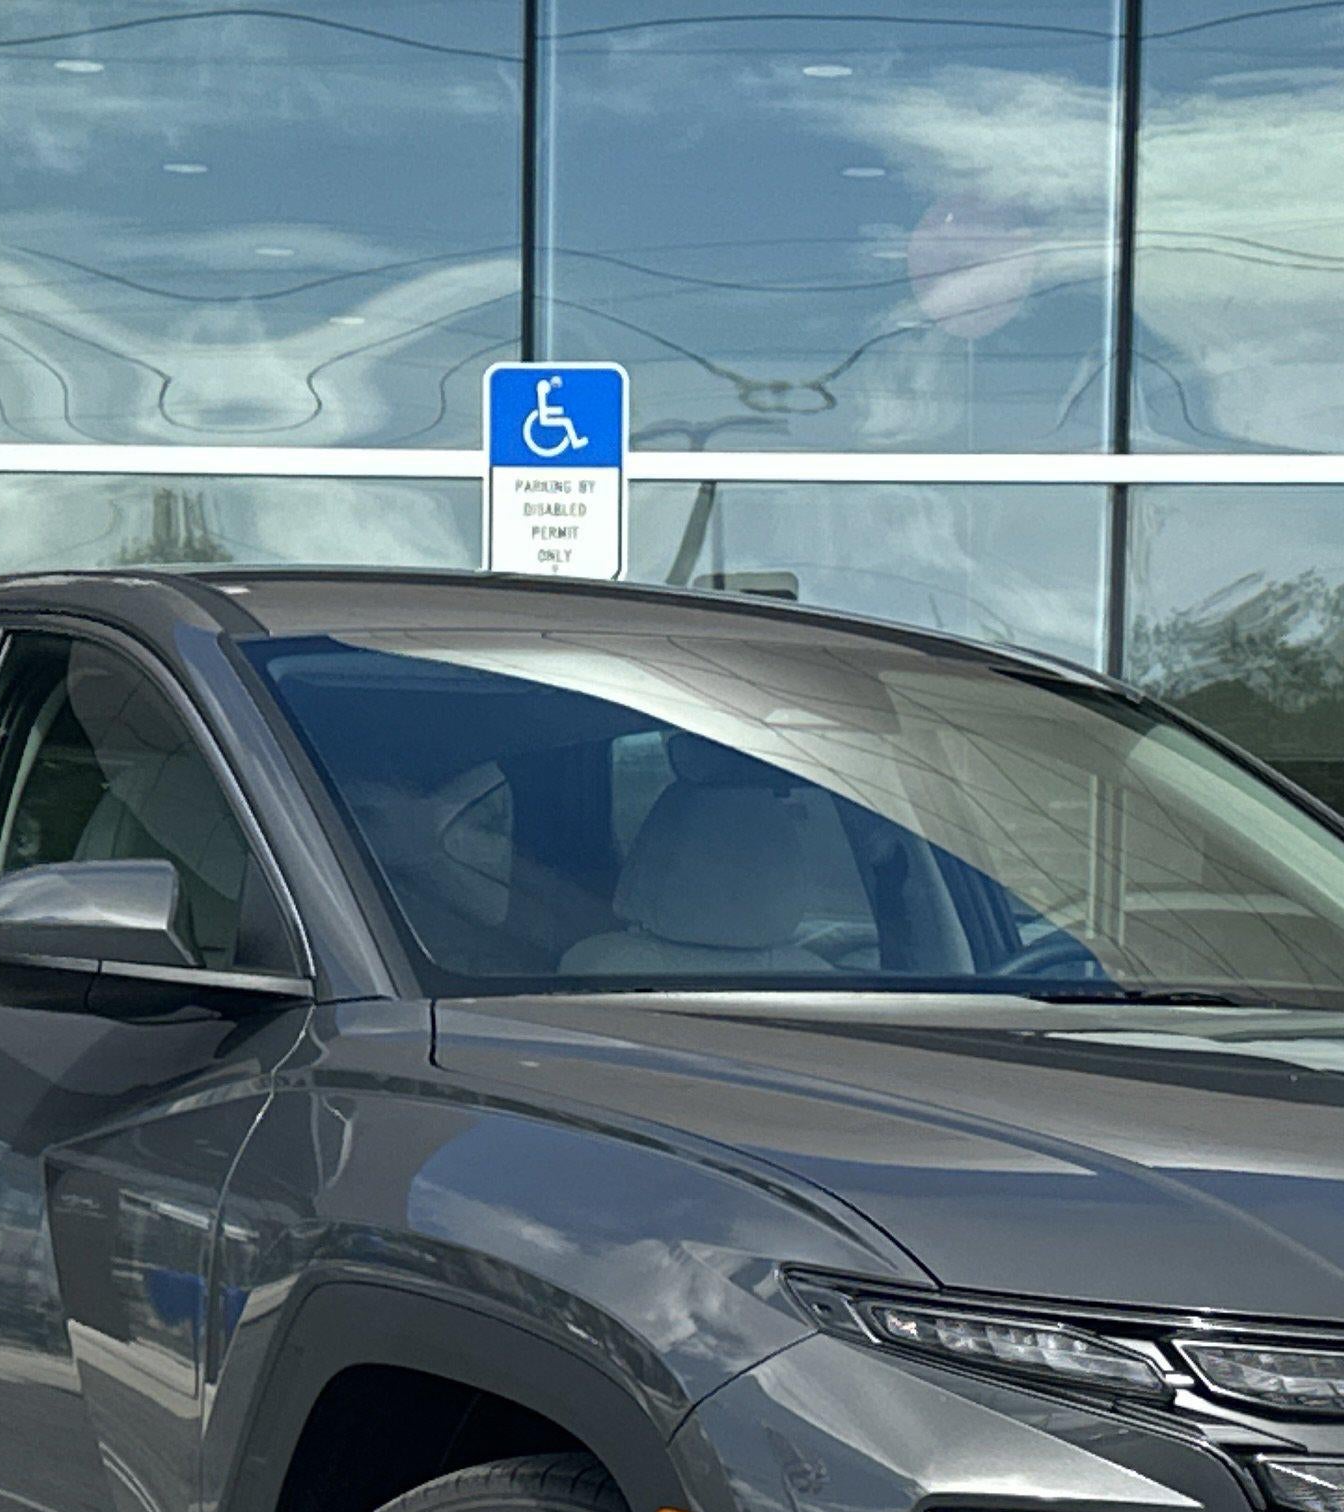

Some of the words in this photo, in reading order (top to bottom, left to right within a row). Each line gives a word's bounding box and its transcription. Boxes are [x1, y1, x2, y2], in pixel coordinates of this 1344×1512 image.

[514, 479, 572, 494] PARKING
[578, 480, 596, 494] BY
[522, 502, 587, 517] DISABLED
[531, 525, 580, 541] PERMIT
[537, 548, 573, 563] ONLY
